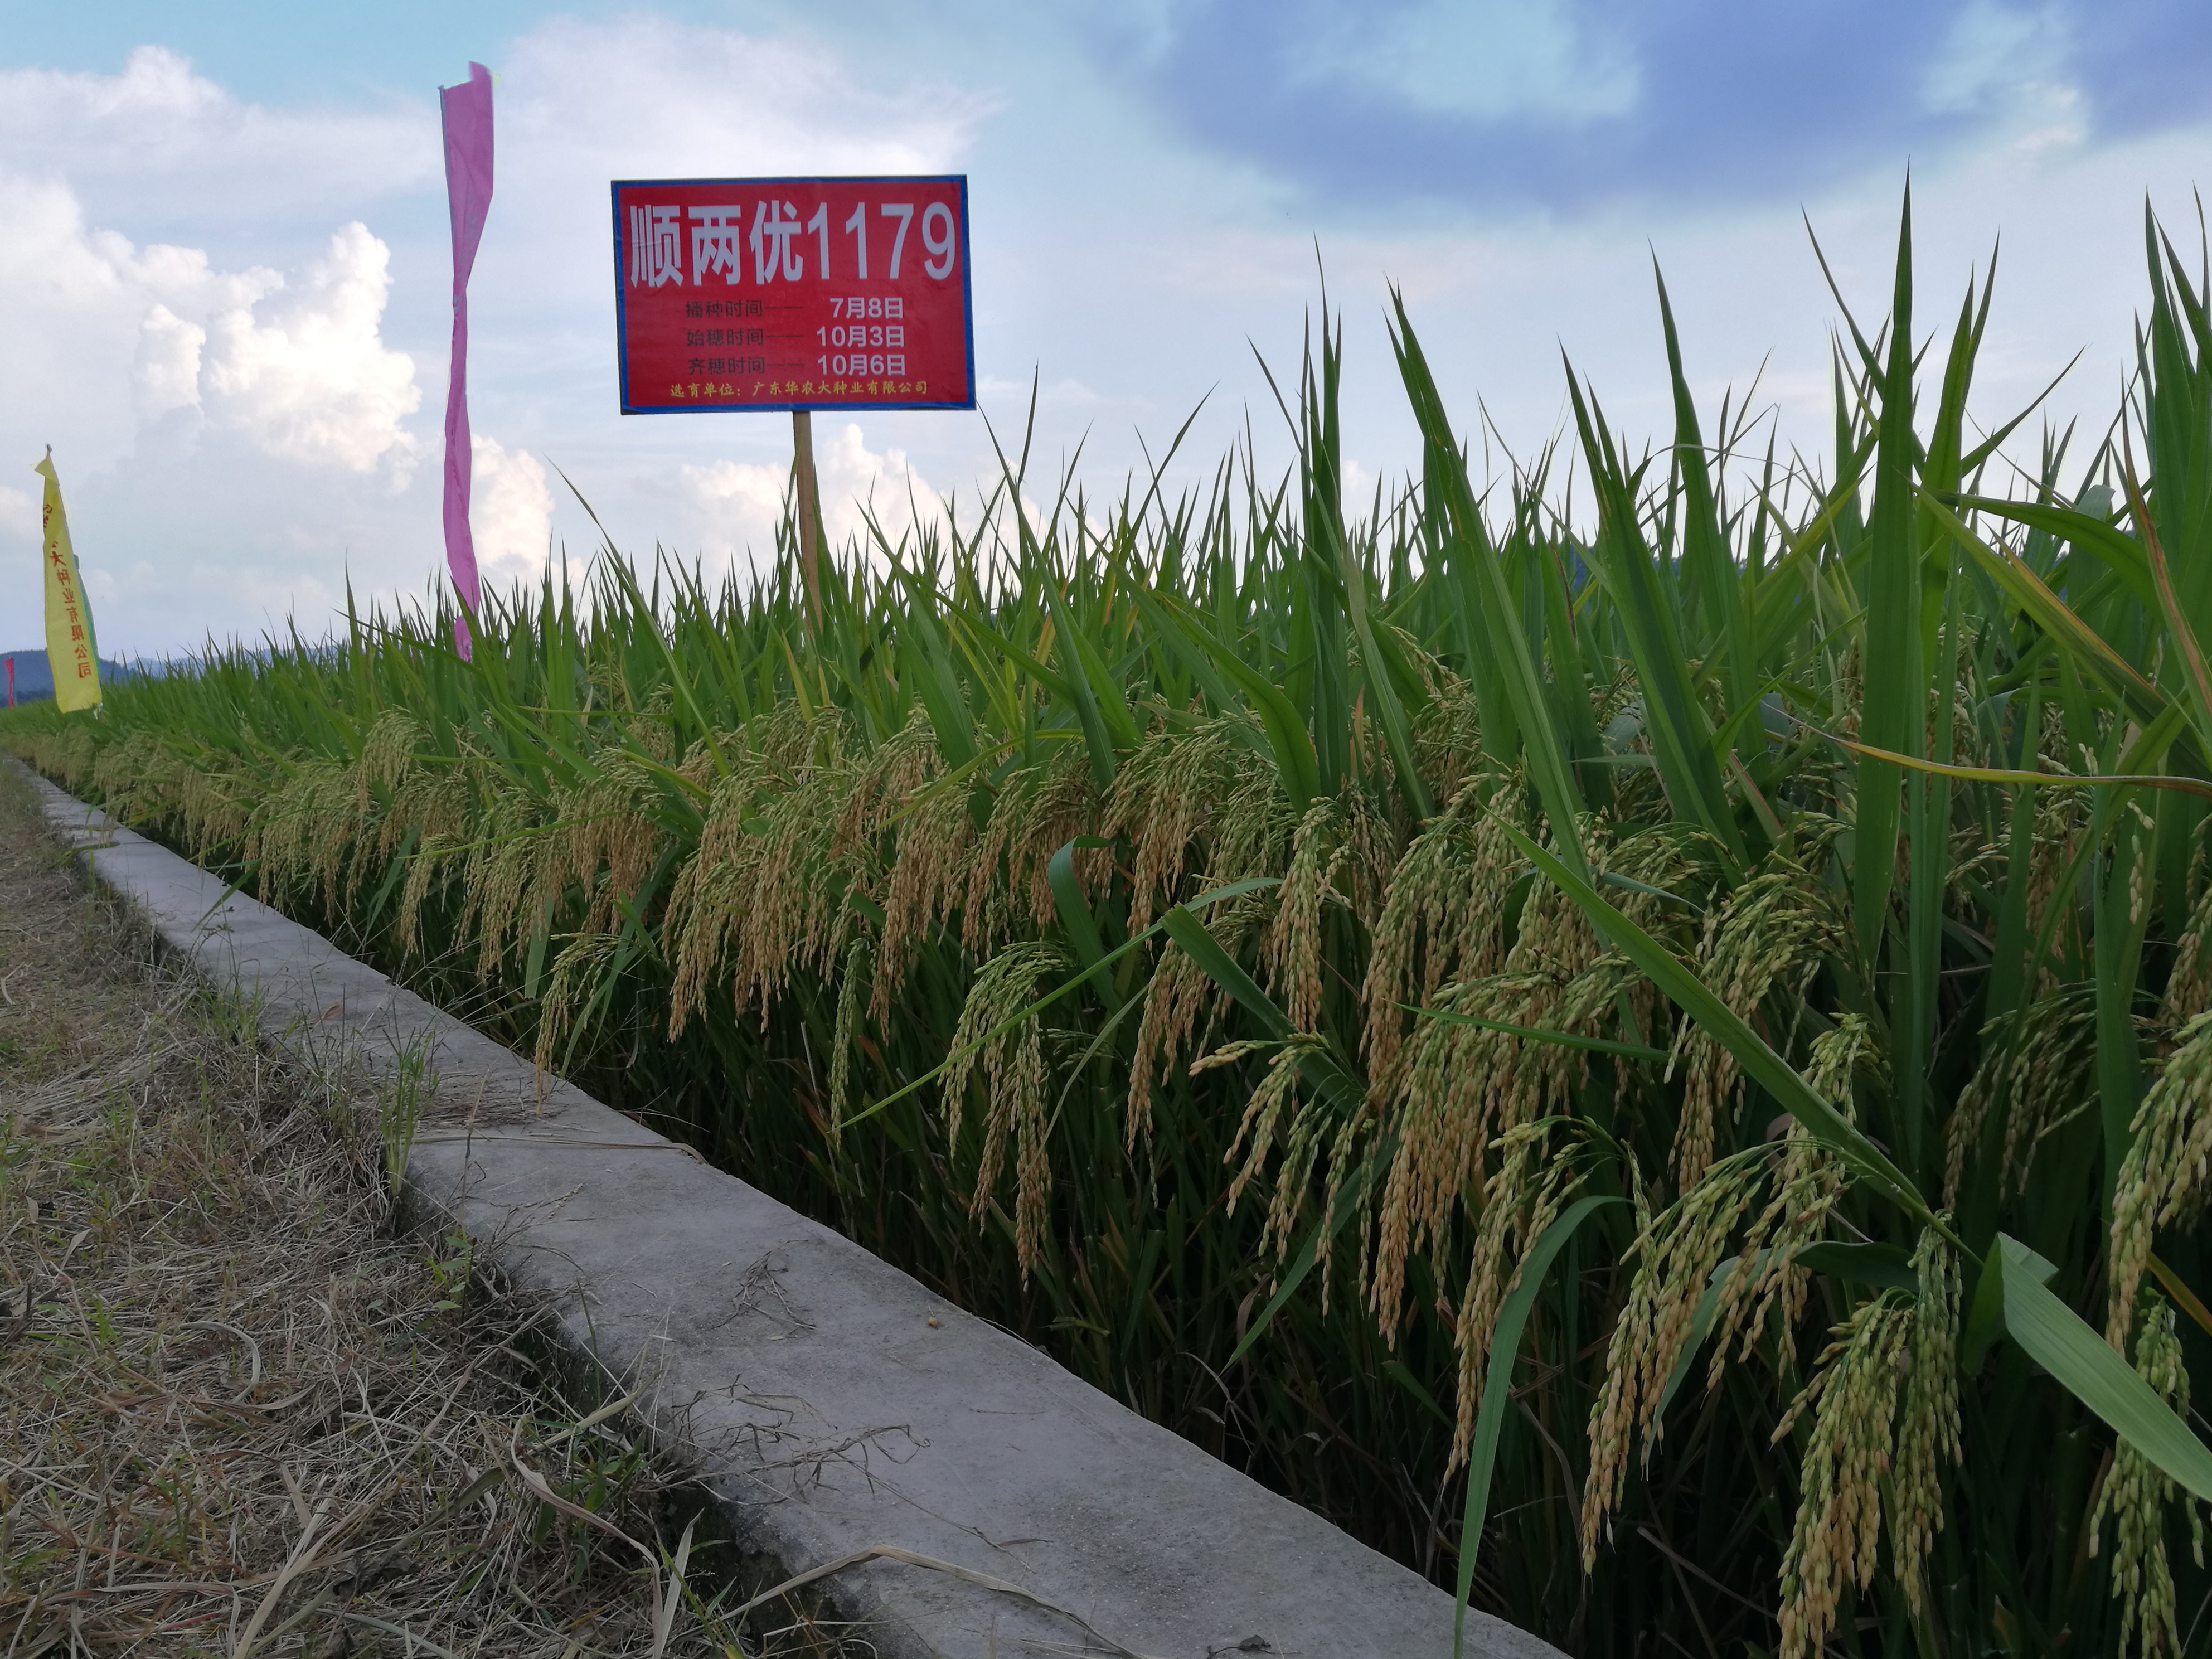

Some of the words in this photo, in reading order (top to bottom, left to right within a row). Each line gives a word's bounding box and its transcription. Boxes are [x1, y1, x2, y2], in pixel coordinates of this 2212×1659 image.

[629, 200, 956, 288] 顺两优1179
[830, 297, 904, 319] 7月8日
[816, 326, 905, 348] 10月3日
[817, 354, 906, 376] 10月6日
